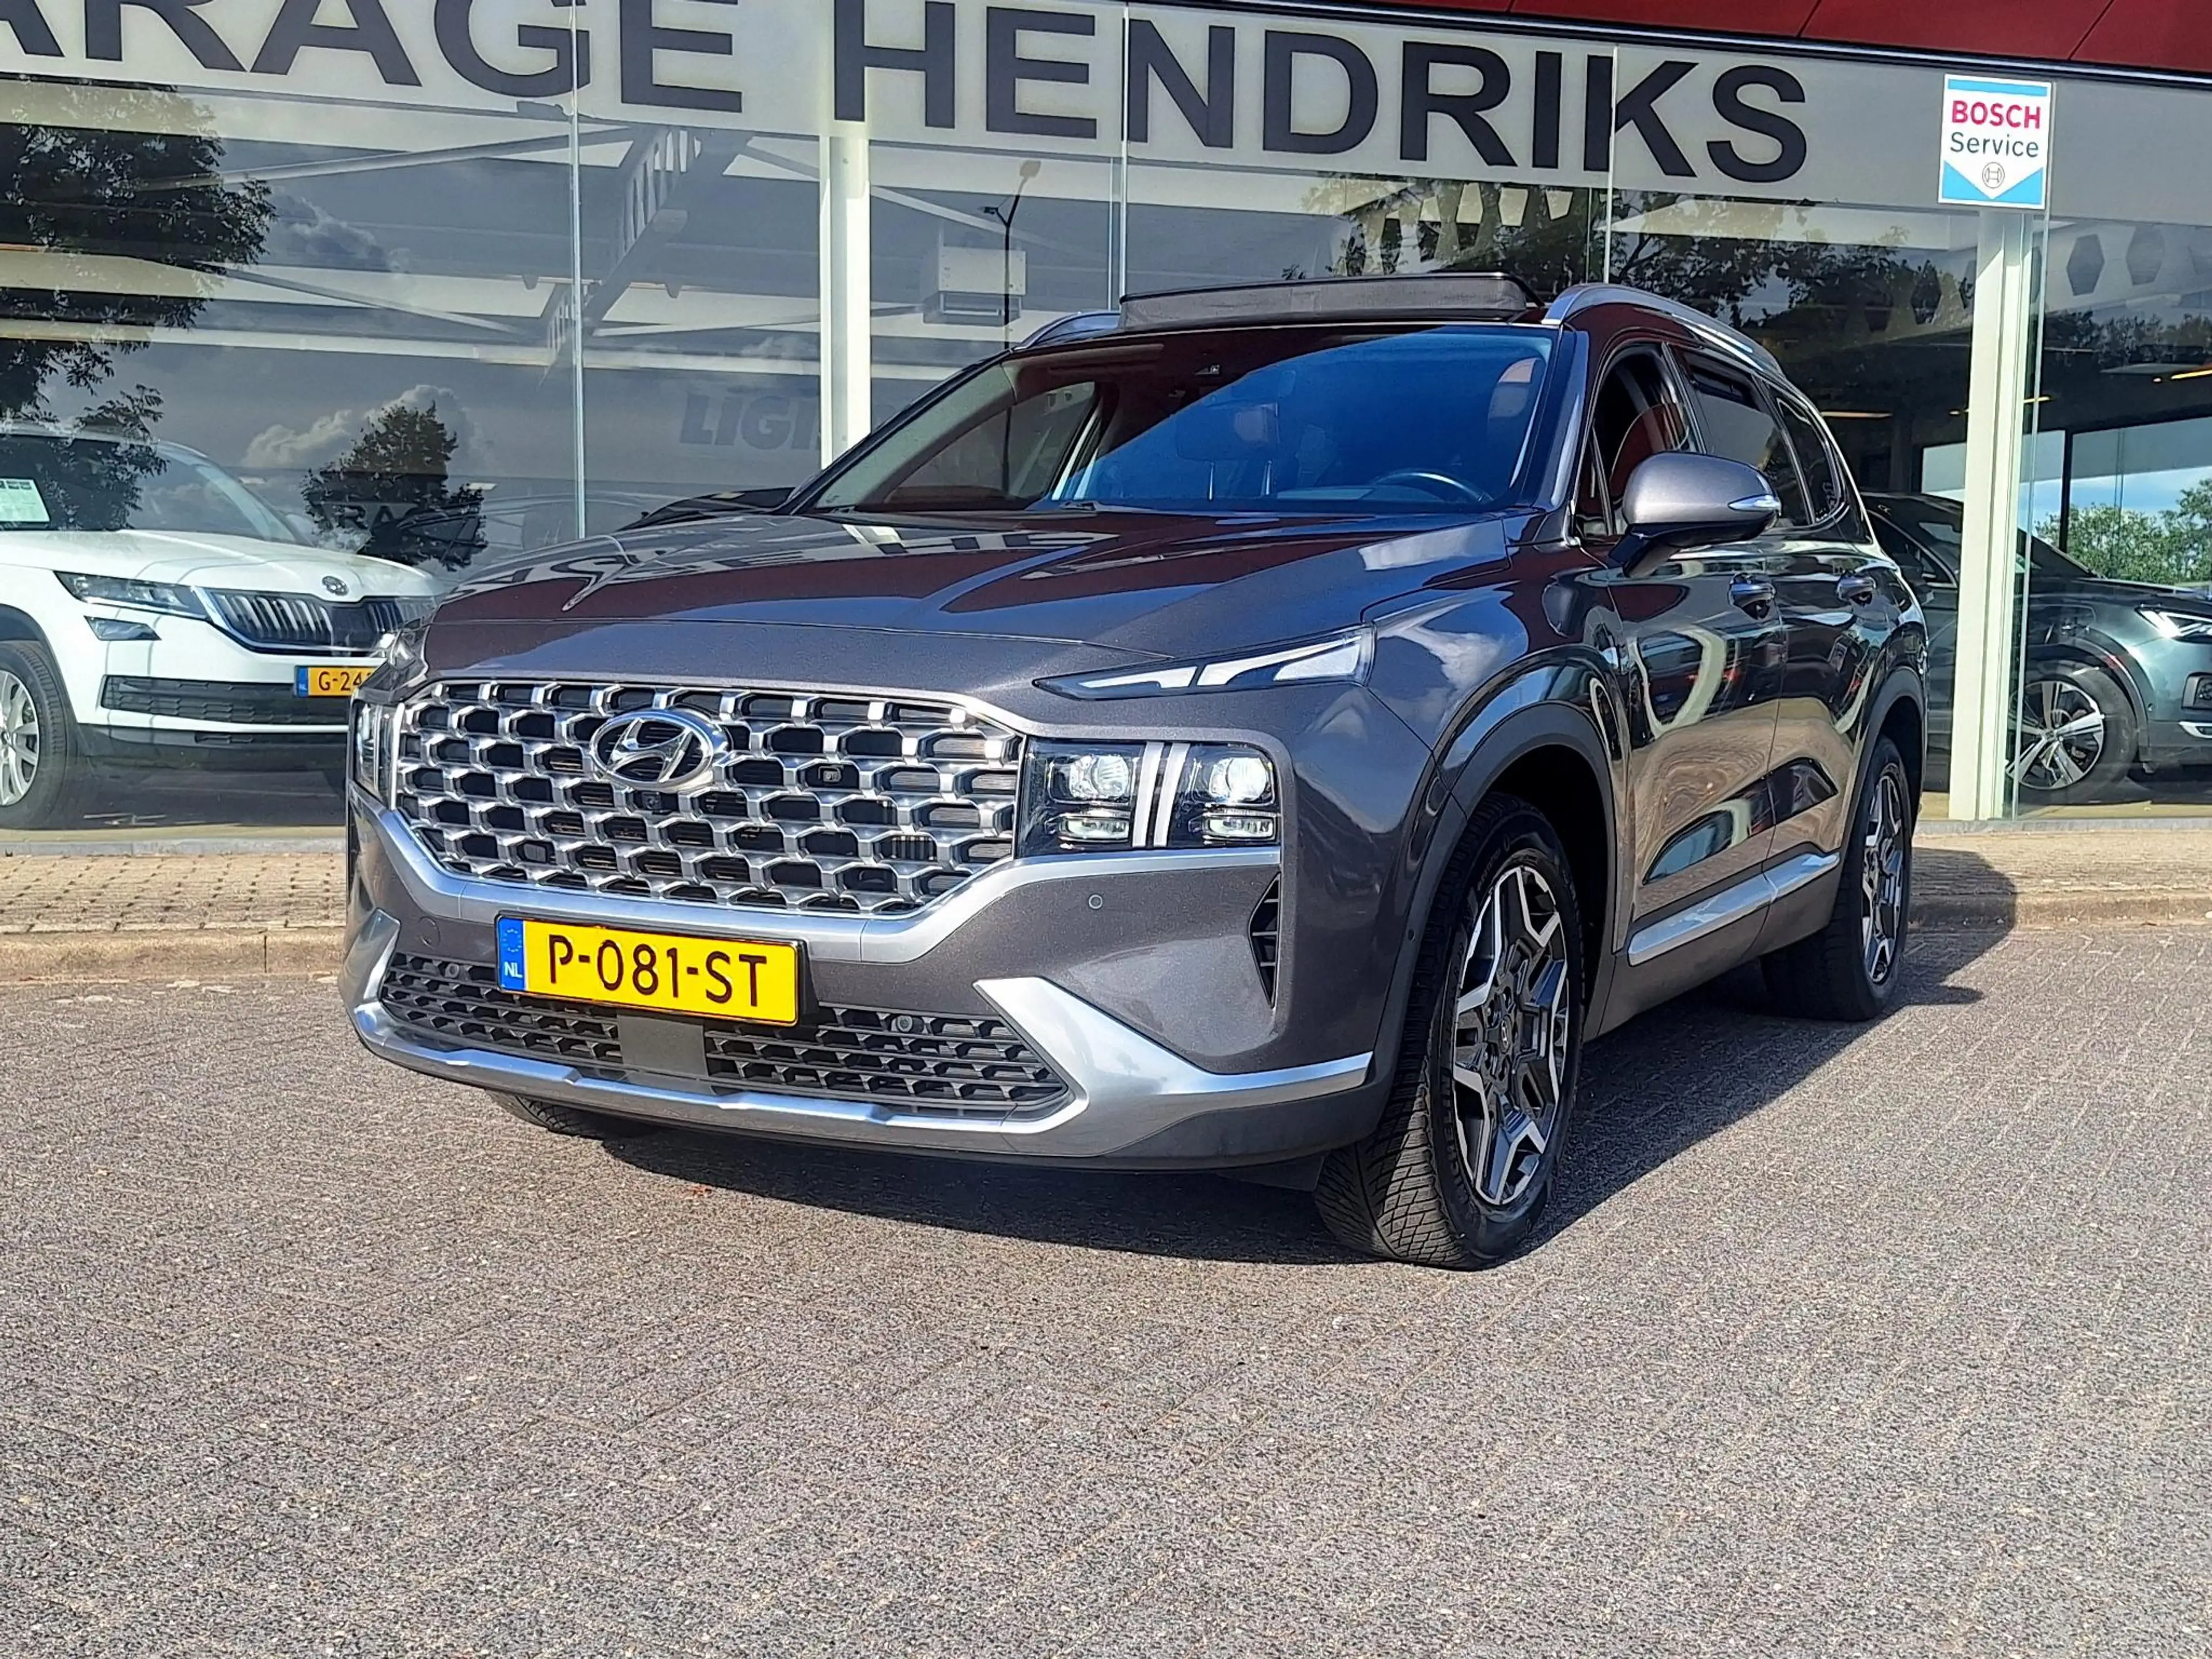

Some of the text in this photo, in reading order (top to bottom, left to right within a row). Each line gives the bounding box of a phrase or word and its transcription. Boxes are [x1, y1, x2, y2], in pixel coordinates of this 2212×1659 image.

[0, 0, 1807, 183] RAGE HENDRIKS
[1952, 100, 2041, 129] BOSCH
[1950, 131, 2039, 158] Service
[319, 671, 371, 691] G-24
[503, 962, 522, 979] NL
[549, 934, 767, 1006] P-081-ST
